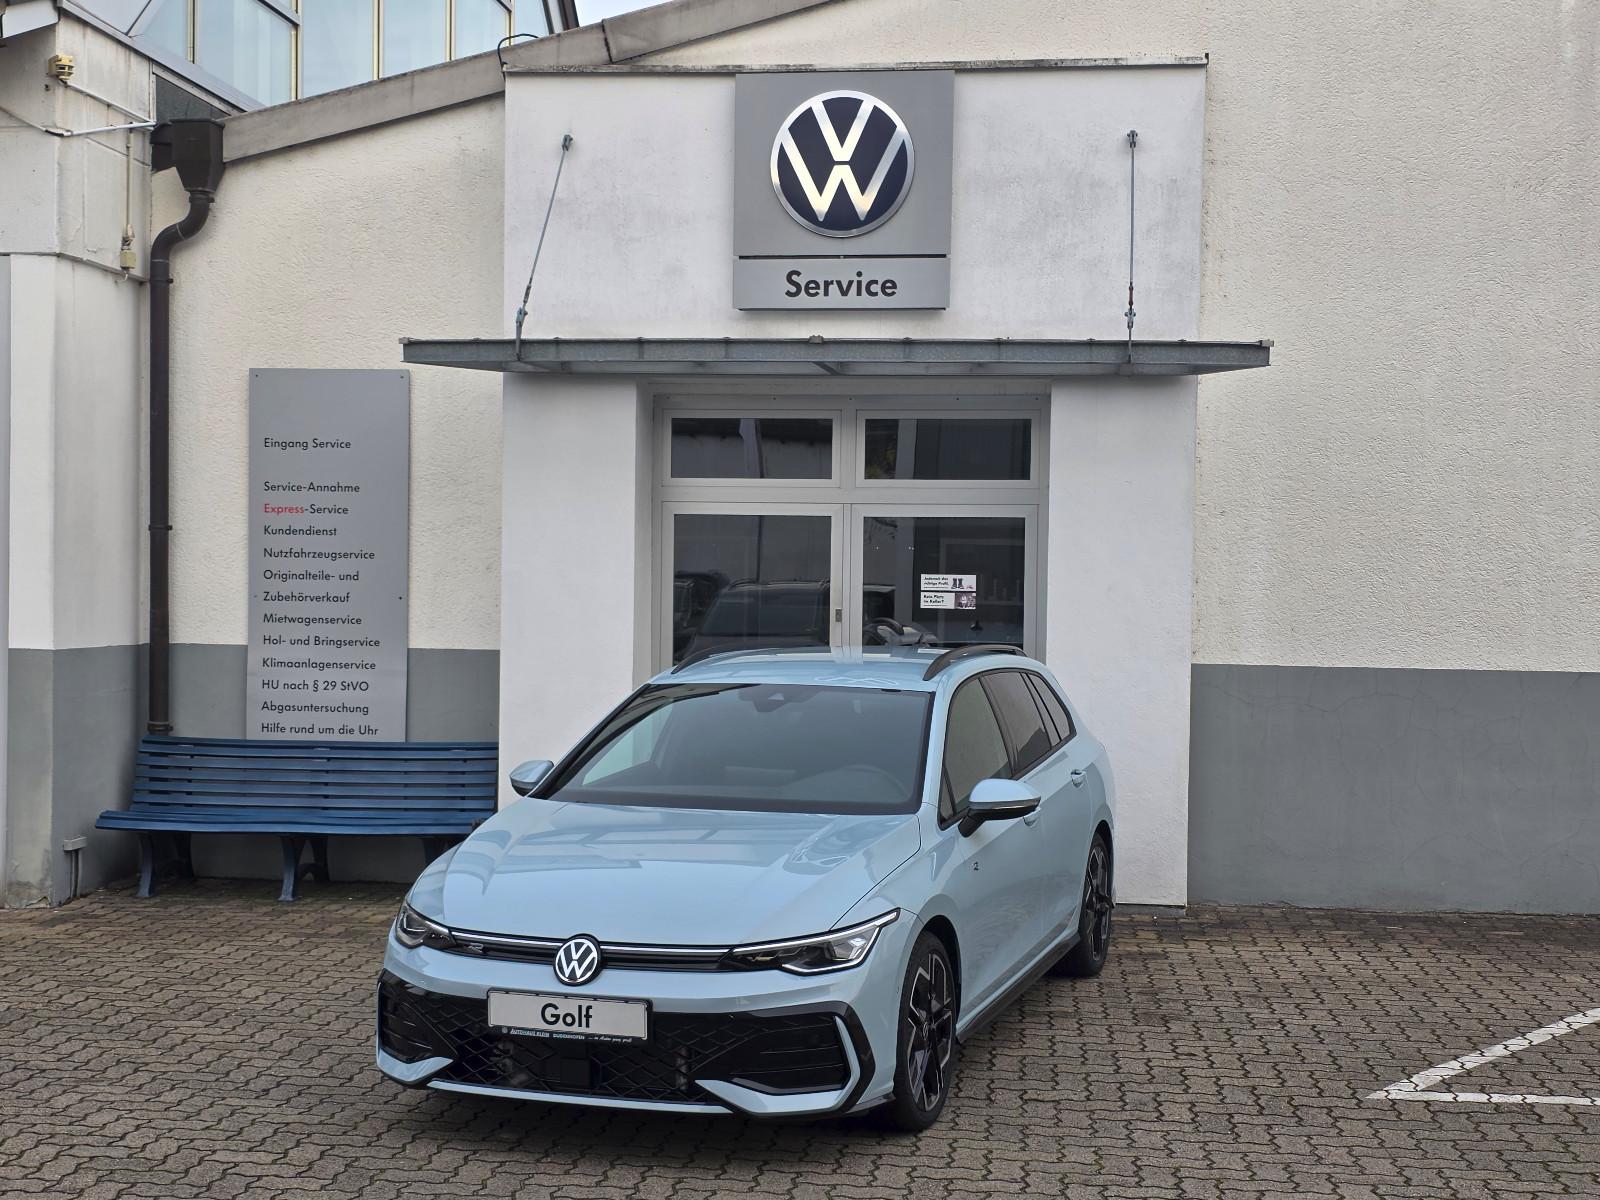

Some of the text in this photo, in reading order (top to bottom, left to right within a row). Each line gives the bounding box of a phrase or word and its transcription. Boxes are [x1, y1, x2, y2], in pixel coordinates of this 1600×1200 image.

[785, 270, 898, 298] Service
[263, 437, 352, 451] Eingang Service
[263, 481, 361, 493] Service-Annahme
[263, 503, 349, 516] Express-Service
[263, 525, 337, 536] Kundendienst
[263, 547, 376, 562] Nutzfahrzeugservice
[263, 569, 359, 582] Originalteile- und
[263, 591, 350, 603] Zubehörverkauf
[263, 613, 362, 626] Mietwagenservice
[263, 635, 380, 648] Hol- und Bringservice
[262, 658, 376, 671] Klimaanlagenservice
[262, 679, 369, 692] HU nach § 29 StVO
[261, 701, 369, 715] Abgasuntersuchung
[261, 722, 379, 736] Hilfe rund um die Uhr
[540, 1002, 593, 1028] Golf
